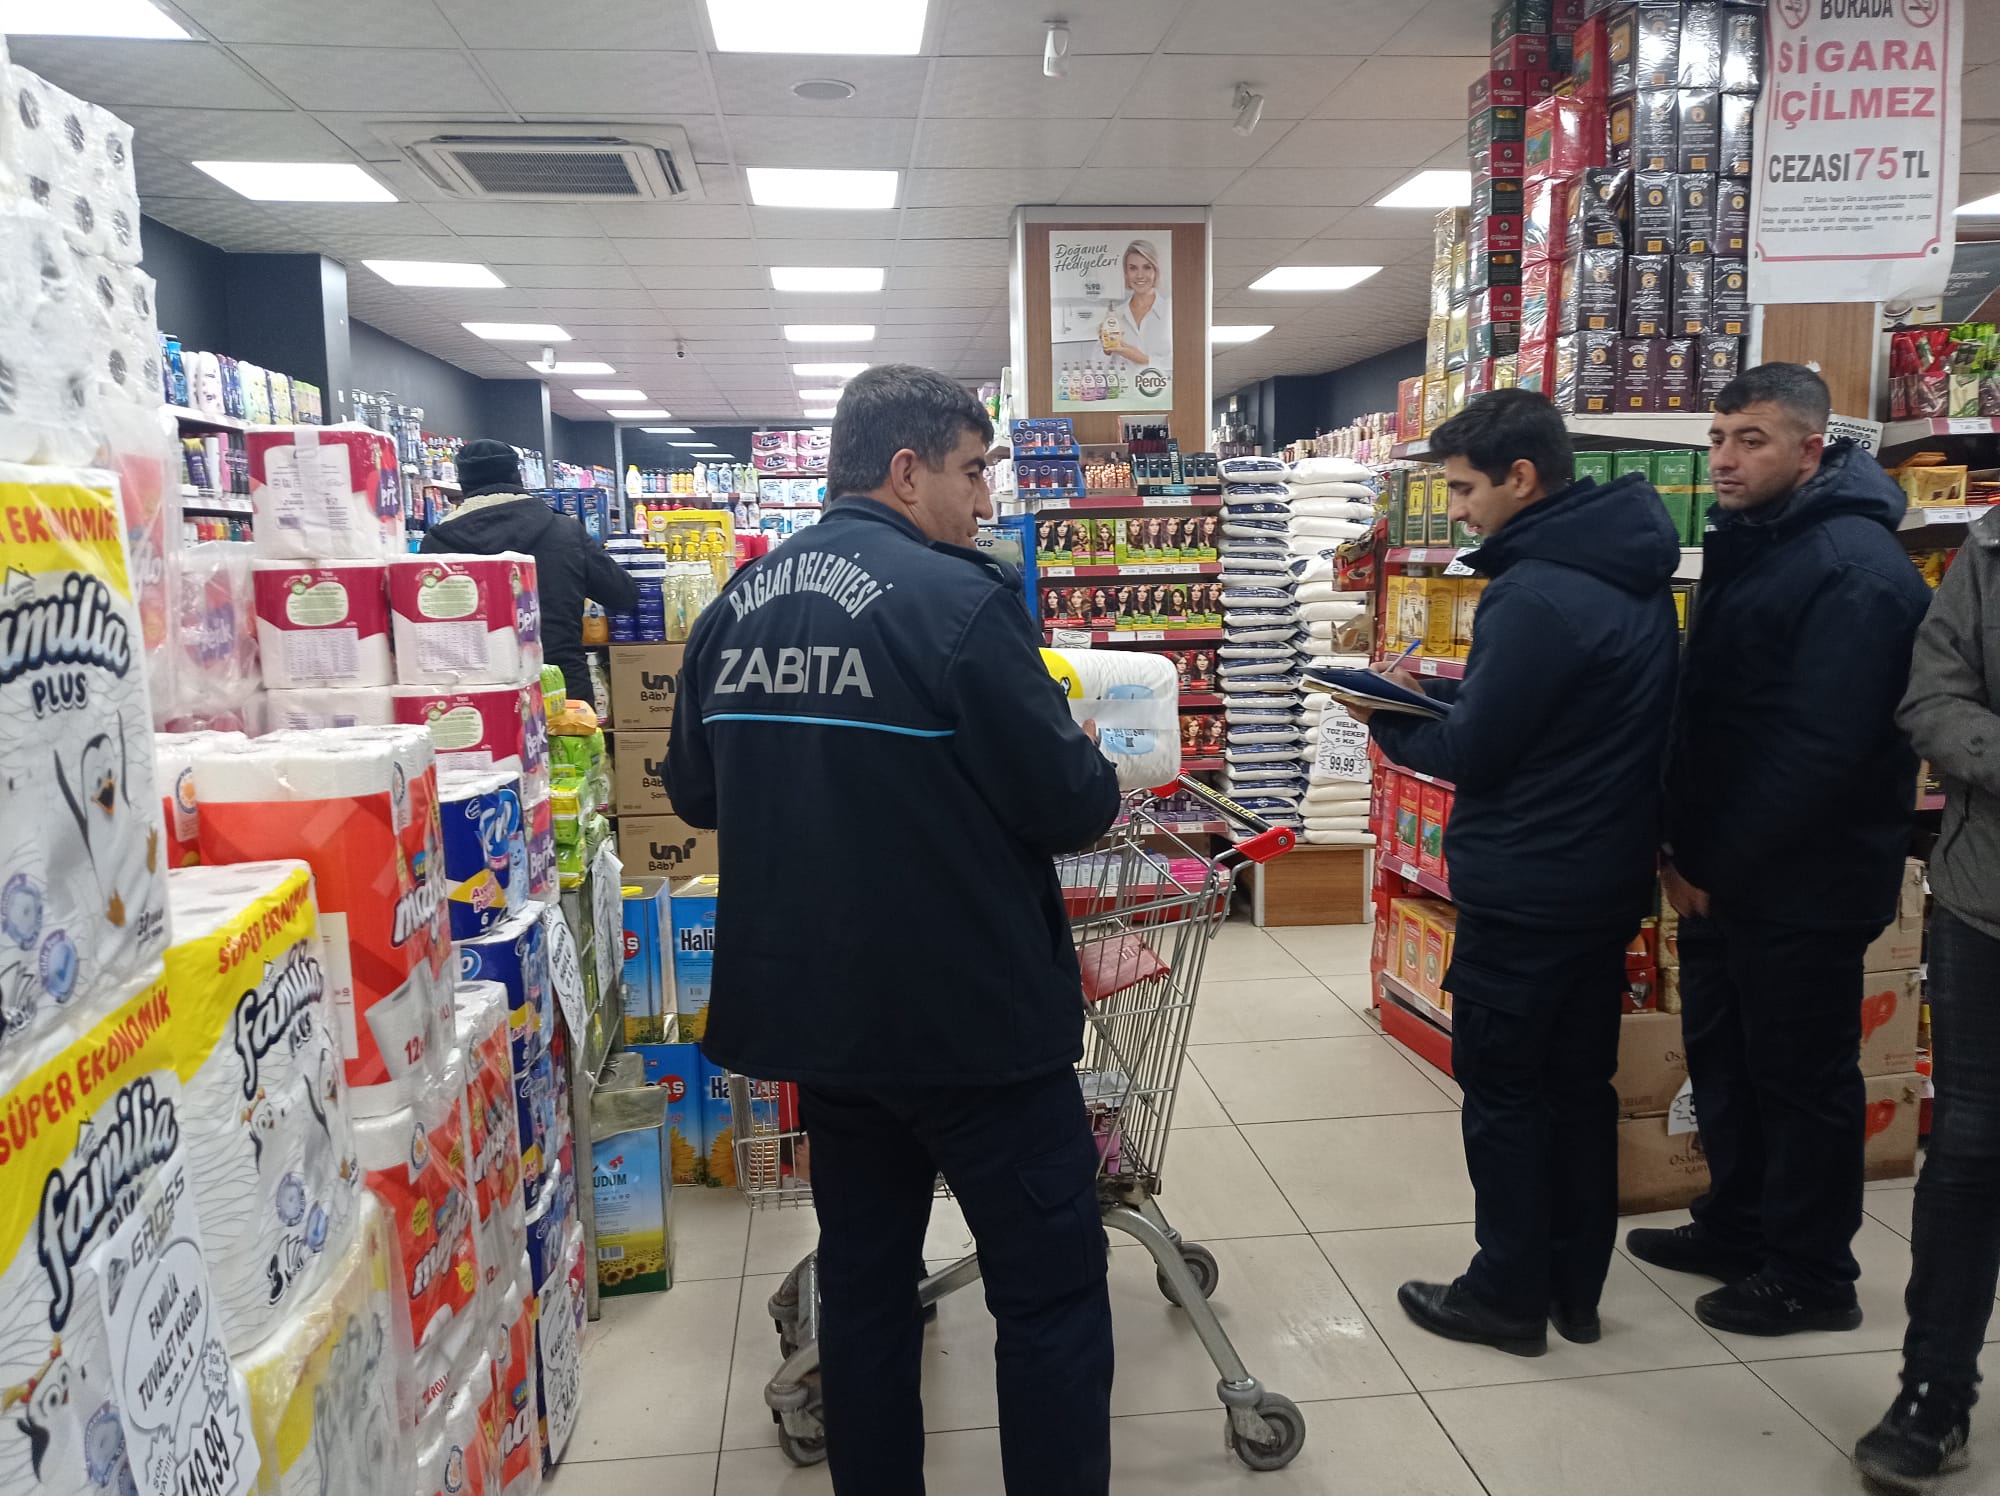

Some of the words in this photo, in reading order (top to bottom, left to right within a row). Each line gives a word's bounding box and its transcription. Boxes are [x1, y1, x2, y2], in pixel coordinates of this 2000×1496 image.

[1819, 0, 1894, 20] BURADA
[1777, 36, 1937, 75] SİGARA
[1772, 82, 1936, 130] İÇİLMEZ
[1768, 152, 1850, 183] CEZASI
[1854, 147, 1899, 181] 75
[1903, 150, 1930, 178] TL
[1055, 243, 1108, 263] Doğanın
[1053, 254, 1119, 277] Hediyeleri
[1135, 375, 1167, 389] Peros
[728, 564, 793, 622] BAĞLAR
[796, 550, 894, 620] BELEDİYESİ
[713, 646, 874, 698] ZABITA
[31, 671, 87, 720] PLUS
[640, 691, 668, 701] Baby
[1329, 756, 1355, 773] 99,99
[642, 777, 664, 788] Bab
[648, 861, 675, 872] Baby
[680, 928, 716, 951] Hali
[0, 1070, 76, 1166] SÜPER
[76, 985, 173, 1096] EKONOMİK
[592, 1173, 628, 1186] UDUM
[37, 1076, 180, 1333] familia
[138, 1329, 177, 1412] TUVALET
